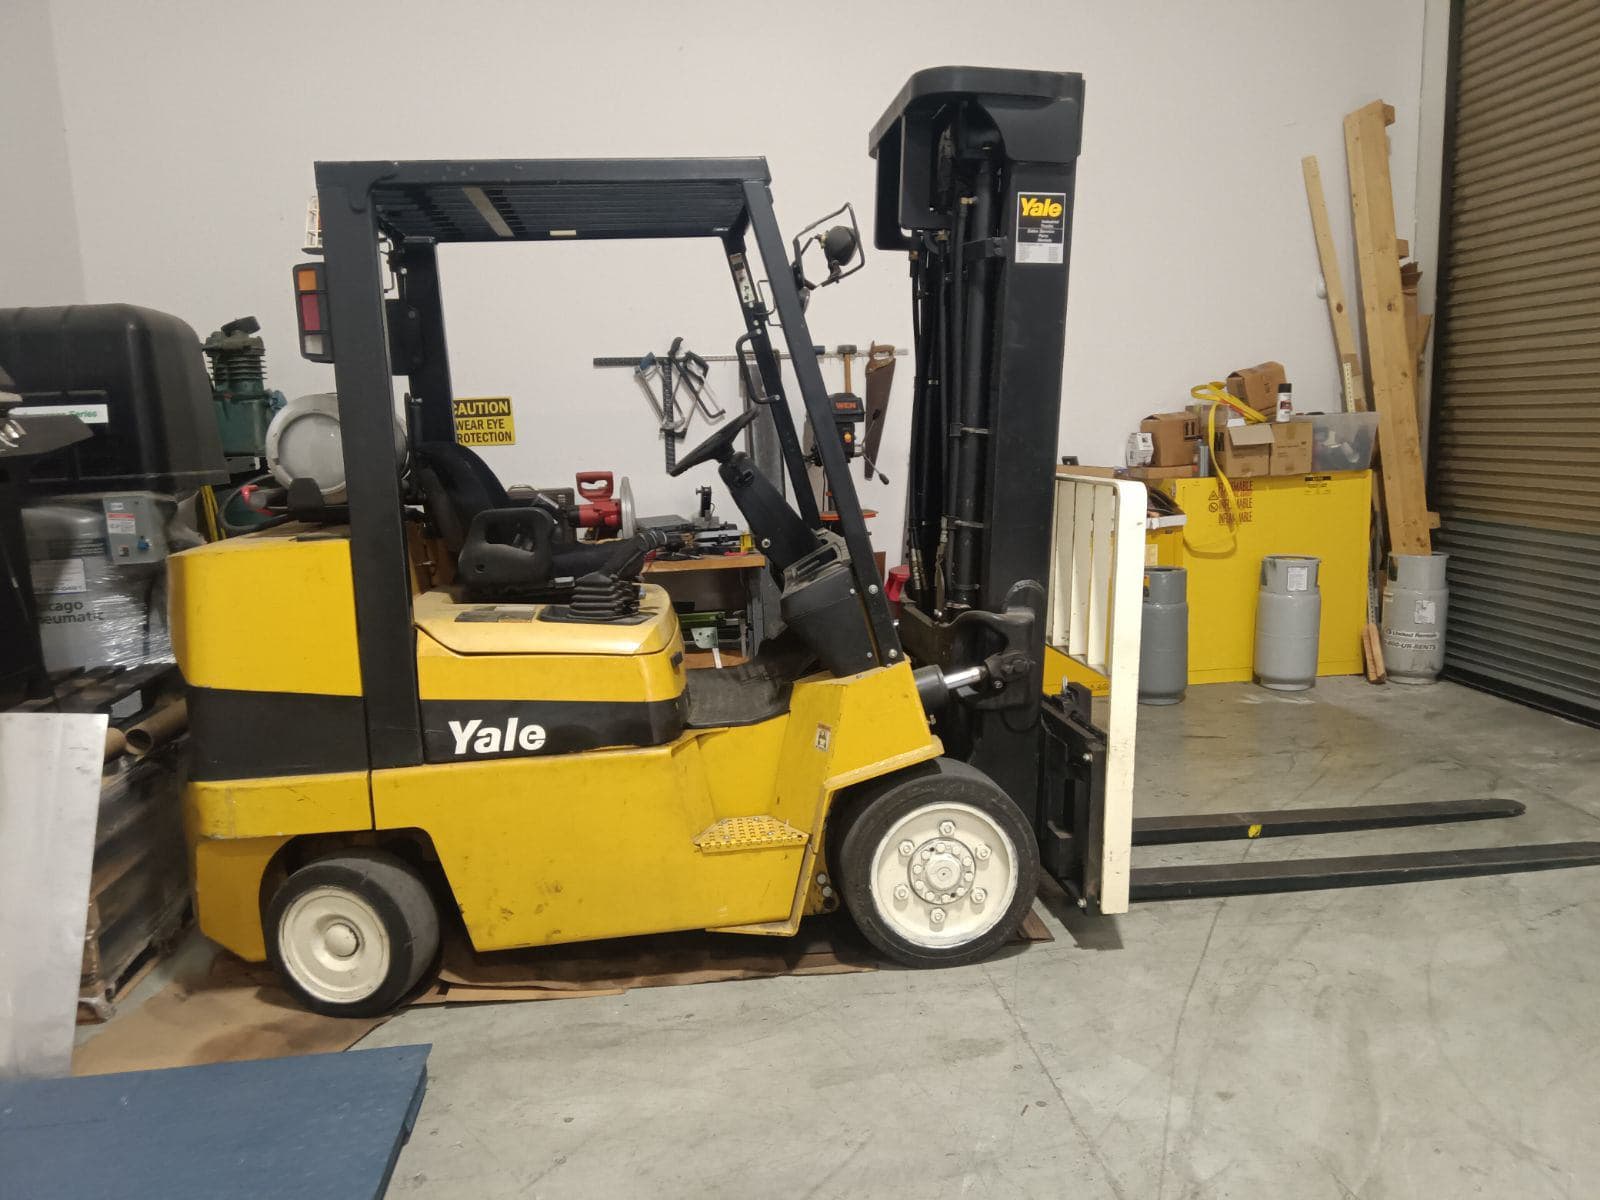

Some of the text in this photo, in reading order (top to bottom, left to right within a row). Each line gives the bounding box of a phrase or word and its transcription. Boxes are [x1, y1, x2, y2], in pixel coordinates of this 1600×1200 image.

[1020, 197, 1062, 217] Yale
[487, 418, 504, 429] EYE
[457, 431, 512, 443] ROTECTION
[448, 717, 546, 754] Yale
